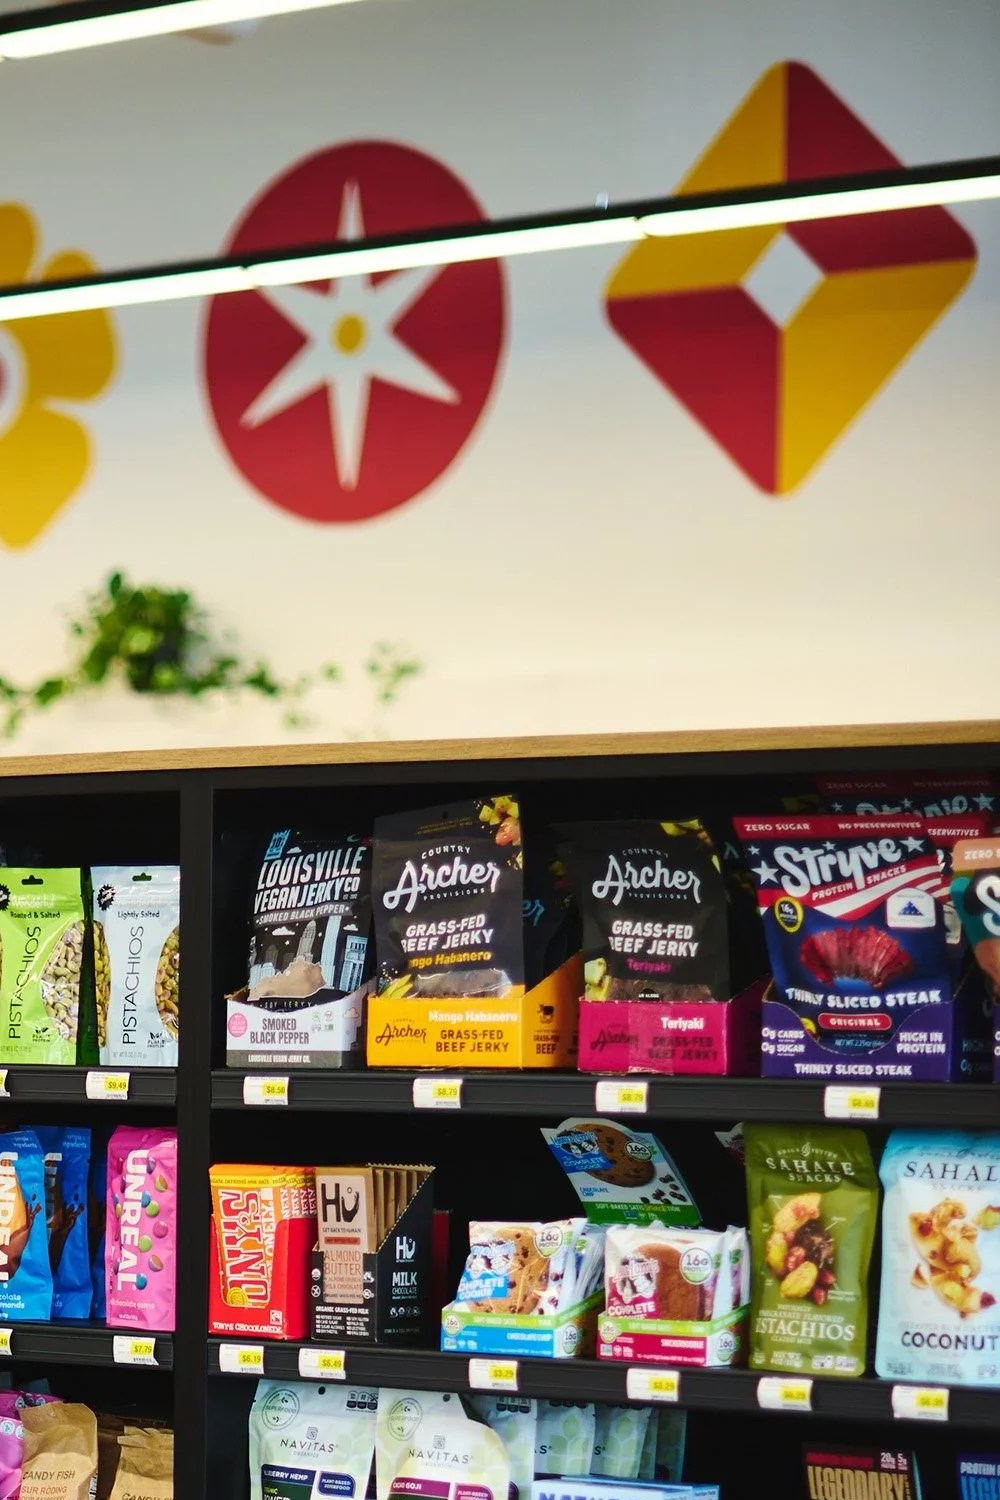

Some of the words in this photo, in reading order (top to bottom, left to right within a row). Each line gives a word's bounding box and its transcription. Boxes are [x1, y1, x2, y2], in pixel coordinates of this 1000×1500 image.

[421, 844, 470, 858] COUNTRY
[258, 847, 366, 888] LOUISVILLE
[774, 837, 902, 898] Stryve
[867, 865, 907, 884] SNACKS
[383, 856, 500, 913] Archer
[592, 855, 701, 905] Archer
[254, 886, 301, 914] VEGAN
[297, 879, 344, 908] JERKY
[344, 876, 360, 894] CO
[406, 914, 486, 938] GRASS-FED
[612, 921, 693, 939] GRASS-FED
[442, 929, 494, 950] JERKY
[647, 939, 698, 957] JERKY
[435, 951, 491, 964] Habanero
[9, 926, 41, 1040] PISTACHIOS
[123, 926, 144, 1044] PISTACHIOS
[827, 994, 881, 1009] SLICED
[886, 989, 942, 1005] STEAK
[262, 1018, 297, 1030] SMOKED
[429, 1011, 462, 1023] Mango
[465, 1011, 517, 1022] Habanero
[661, 1017, 703, 1031] Teriyaki
[251, 1032, 276, 1044] BLACK
[279, 1032, 309, 1044] PEPPER
[376, 1023, 427, 1046] Archer
[440, 1029, 503, 1040] GRASS-FED
[900, 1032, 925, 1043] HIGH
[929, 1032, 942, 1043] IN
[436, 1041, 465, 1052] BEEF
[470, 1042, 509, 1053] JERKY
[897, 1043, 945, 1054] PROTEIN
[795, 1064, 832, 1074] THINLY
[835, 1064, 873, 1075] SLICED
[876, 1065, 911, 1075] STEAK
[108, 1081, 126, 1089] $9.49
[766, 1156, 855, 1177] SAHALE
[116, 1150, 147, 1291] UNREAL
[325, 1250, 361, 1262] ALMOND
[325, 1263, 363, 1274] BUTTER
[392, 1272, 417, 1286] MILK
[280, 1438, 334, 1453] NAVITAS
[408, 1449, 468, 1464] NAVITAS
[23, 1471, 51, 1481] CANDY
[52, 1470, 75, 1480] FISH
[407, 1483, 422, 1491] GOJI
